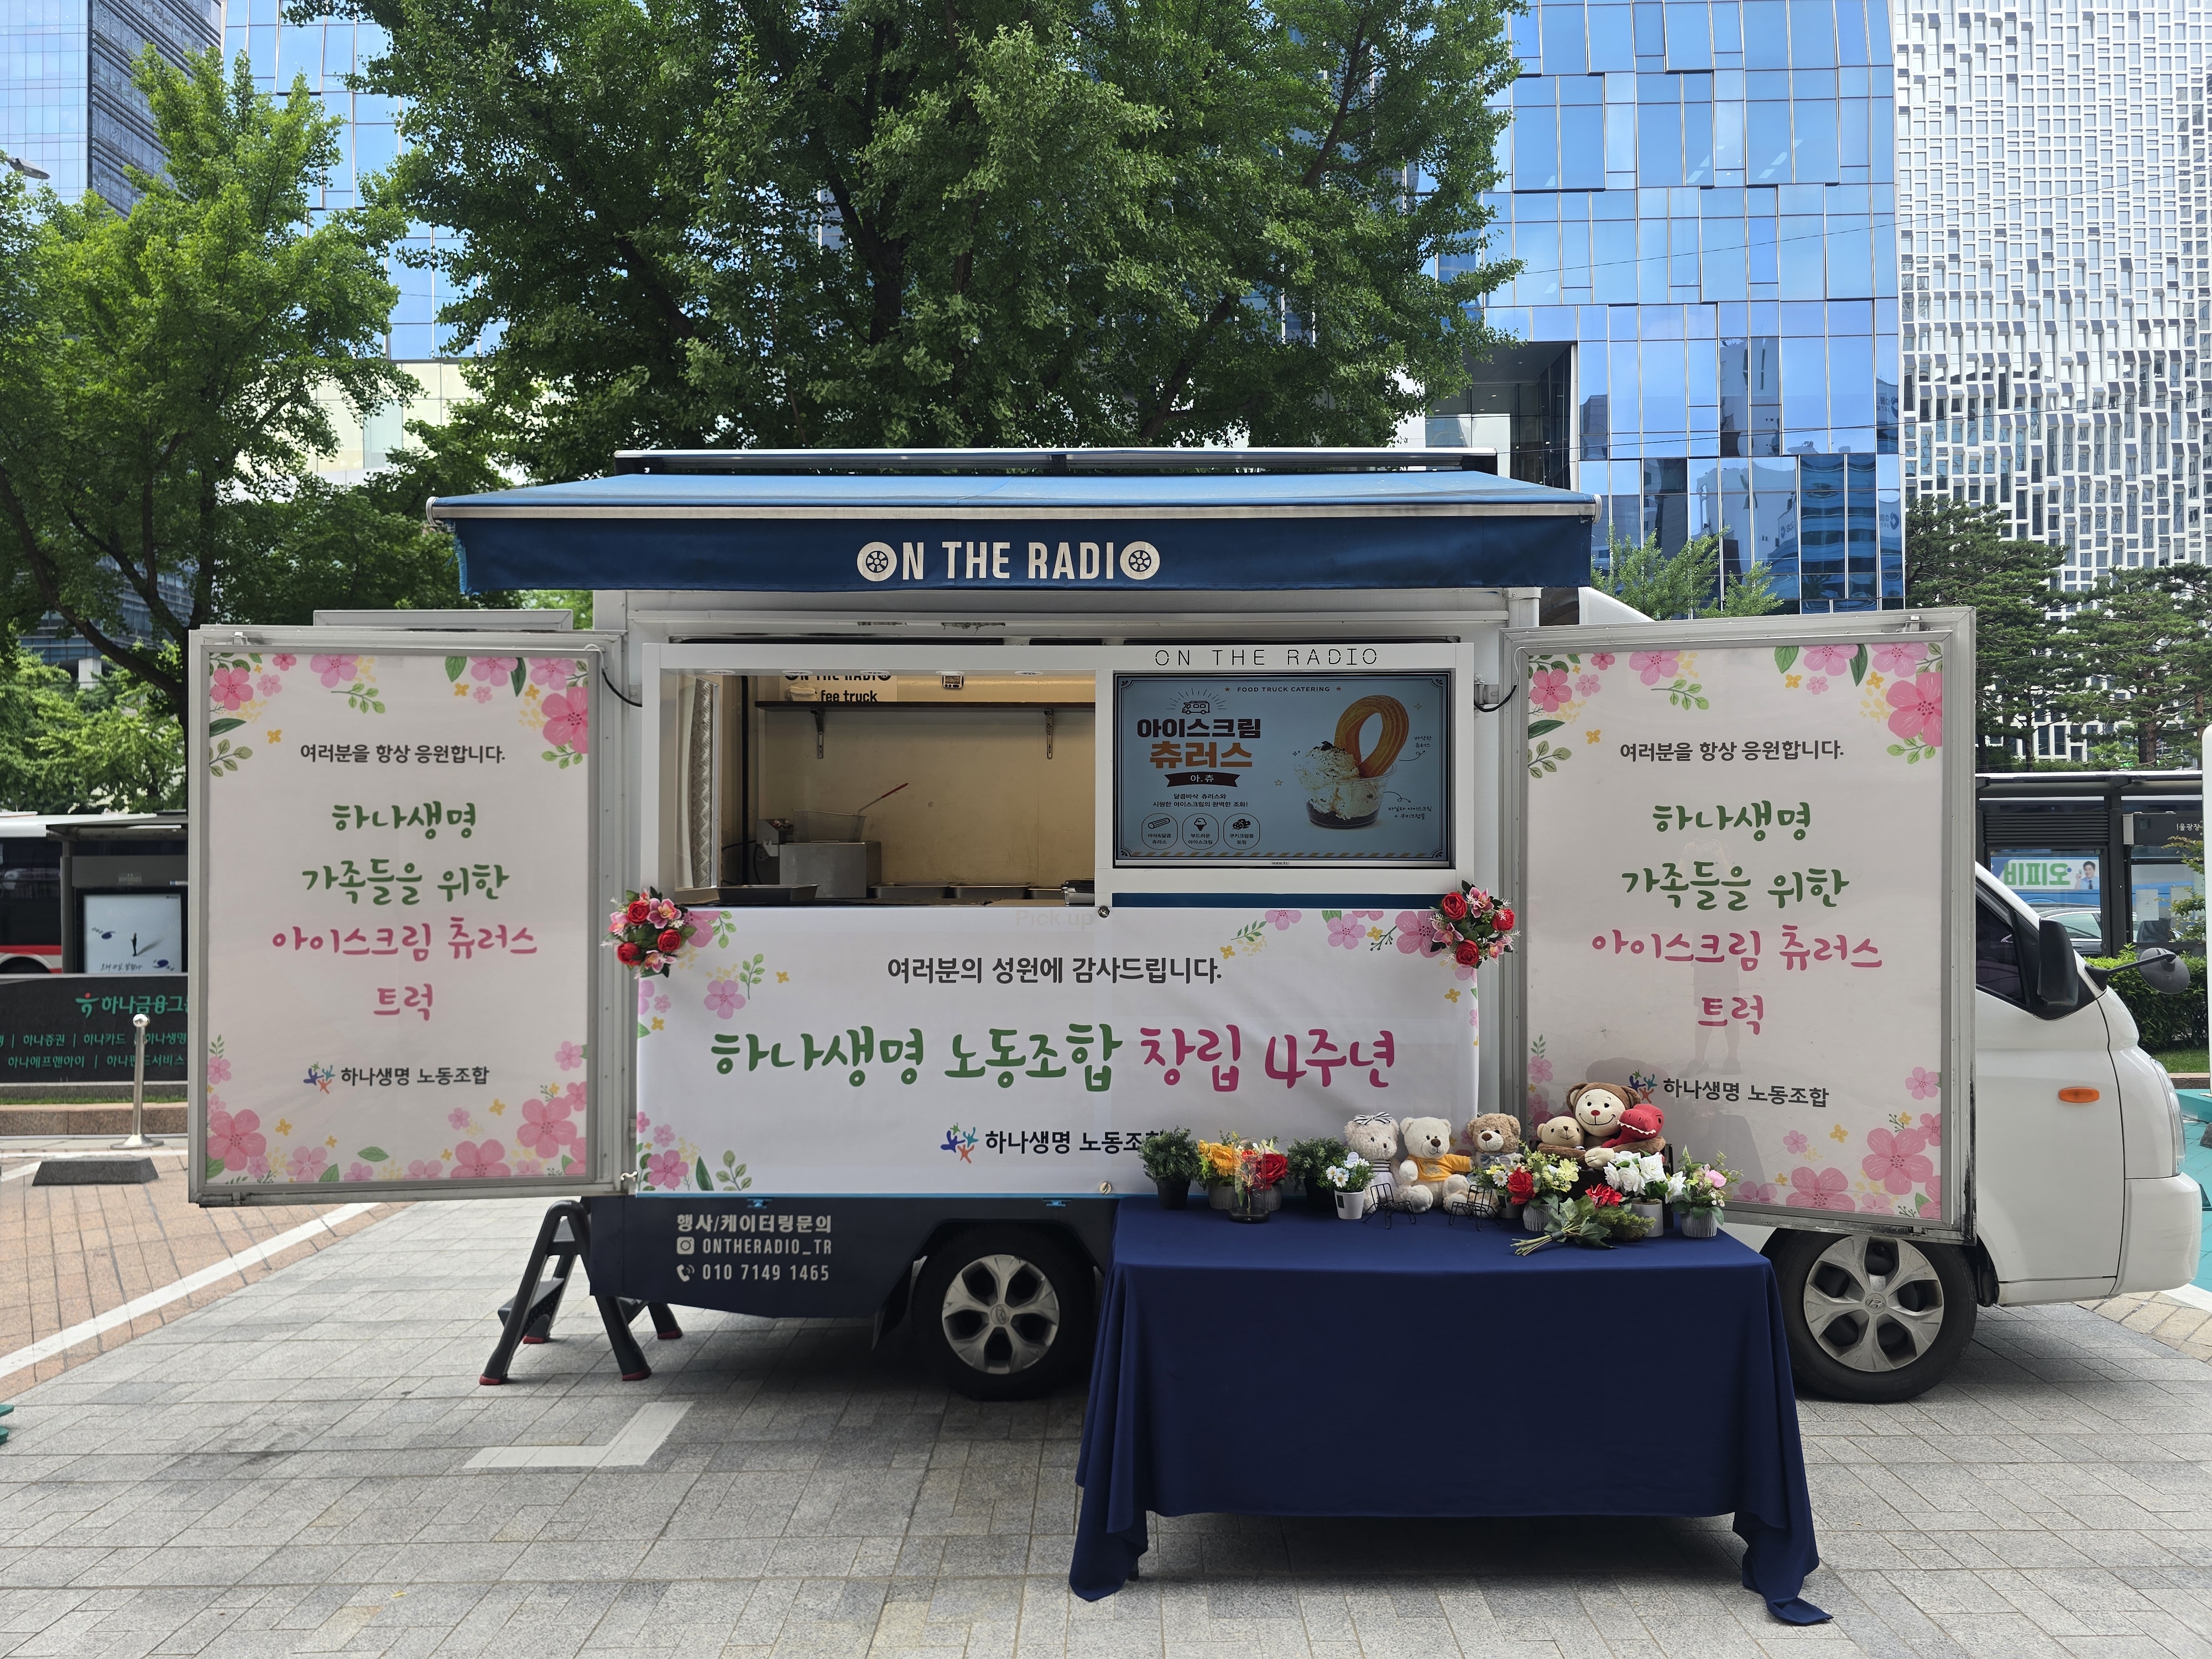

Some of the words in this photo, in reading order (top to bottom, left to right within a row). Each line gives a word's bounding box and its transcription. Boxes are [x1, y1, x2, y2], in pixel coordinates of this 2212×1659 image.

[857, 541, 924, 582] ON
[942, 541, 1010, 579] THE
[1028, 541, 1160, 580] RADIO
[1154, 649, 1191, 666] ON
[1212, 649, 1266, 666] THE
[1286, 648, 1378, 666] RADIO
[843, 690, 878, 702] truck
[1137, 718, 1261, 739] 아이스크림
[300, 744, 370, 763] 여러분을
[375, 744, 411, 764] 항상
[414, 745, 505, 764] 응원합니다.
[1150, 740, 1253, 769] 츄러스
[1620, 742, 1693, 763] 여러분을
[1699, 742, 1738, 761] 항상
[1741, 740, 1844, 761] 응원합니다.
[1190, 774, 1214, 782] 아.츄
[331, 800, 476, 840] 하나생명
[1652, 800, 1811, 842] 하나생명
[2176, 822, 2201, 832] 울광장
[301, 858, 422, 906] 가족들을
[437, 864, 510, 902] 위한
[1621, 860, 1751, 911] 가족들을
[1767, 868, 1850, 909] 위한
[2004, 862, 2071, 886] 비피오
[1015, 909, 1061, 927] Pick
[1067, 912, 1095, 930] up
[272, 922, 431, 962] 아이스크림
[447, 916, 538, 959] 츄러스
[1592, 929, 1761, 972] 아이스크림
[1779, 924, 1882, 971] 츄러스
[888, 957, 982, 984] 여러분의
[992, 957, 1063, 984] 성원에
[1072, 957, 1222, 984] 감사드립니다.
[101, 994, 188, 1015] 하나금융그
[373, 983, 433, 1021] 트럭
[1697, 995, 1764, 1035] 트럭
[23, 1034, 65, 1047] 하나증권
[84, 1033, 126, 1046] 하나카드
[144, 1031, 187, 1046] 하나생명
[8, 1055, 85, 1068] 하나에프앤아이
[711, 1025, 924, 1087] 하나생명
[944, 1023, 1123, 1092] 노동조합
[1140, 1024, 1241, 1092] 창립
[1265, 1029, 1395, 1089] 4주년
[341, 1067, 409, 1087] 하나생명
[416, 1066, 490, 1086] 노동조합
[1663, 1078, 1739, 1102] 하나생명
[1747, 1084, 1829, 1108] 노동조합
[985, 1130, 1070, 1154] 하나생명
[1079, 1130, 1165, 1155] 노동조
[677, 1214, 831, 1233] 행사/케이터링문의
[703, 1238, 832, 1255] ONTHERADIO_TR
[702, 1264, 732, 1280] 010
[740, 1264, 780, 1281] 7149
[790, 1264, 829, 1281] 1465
